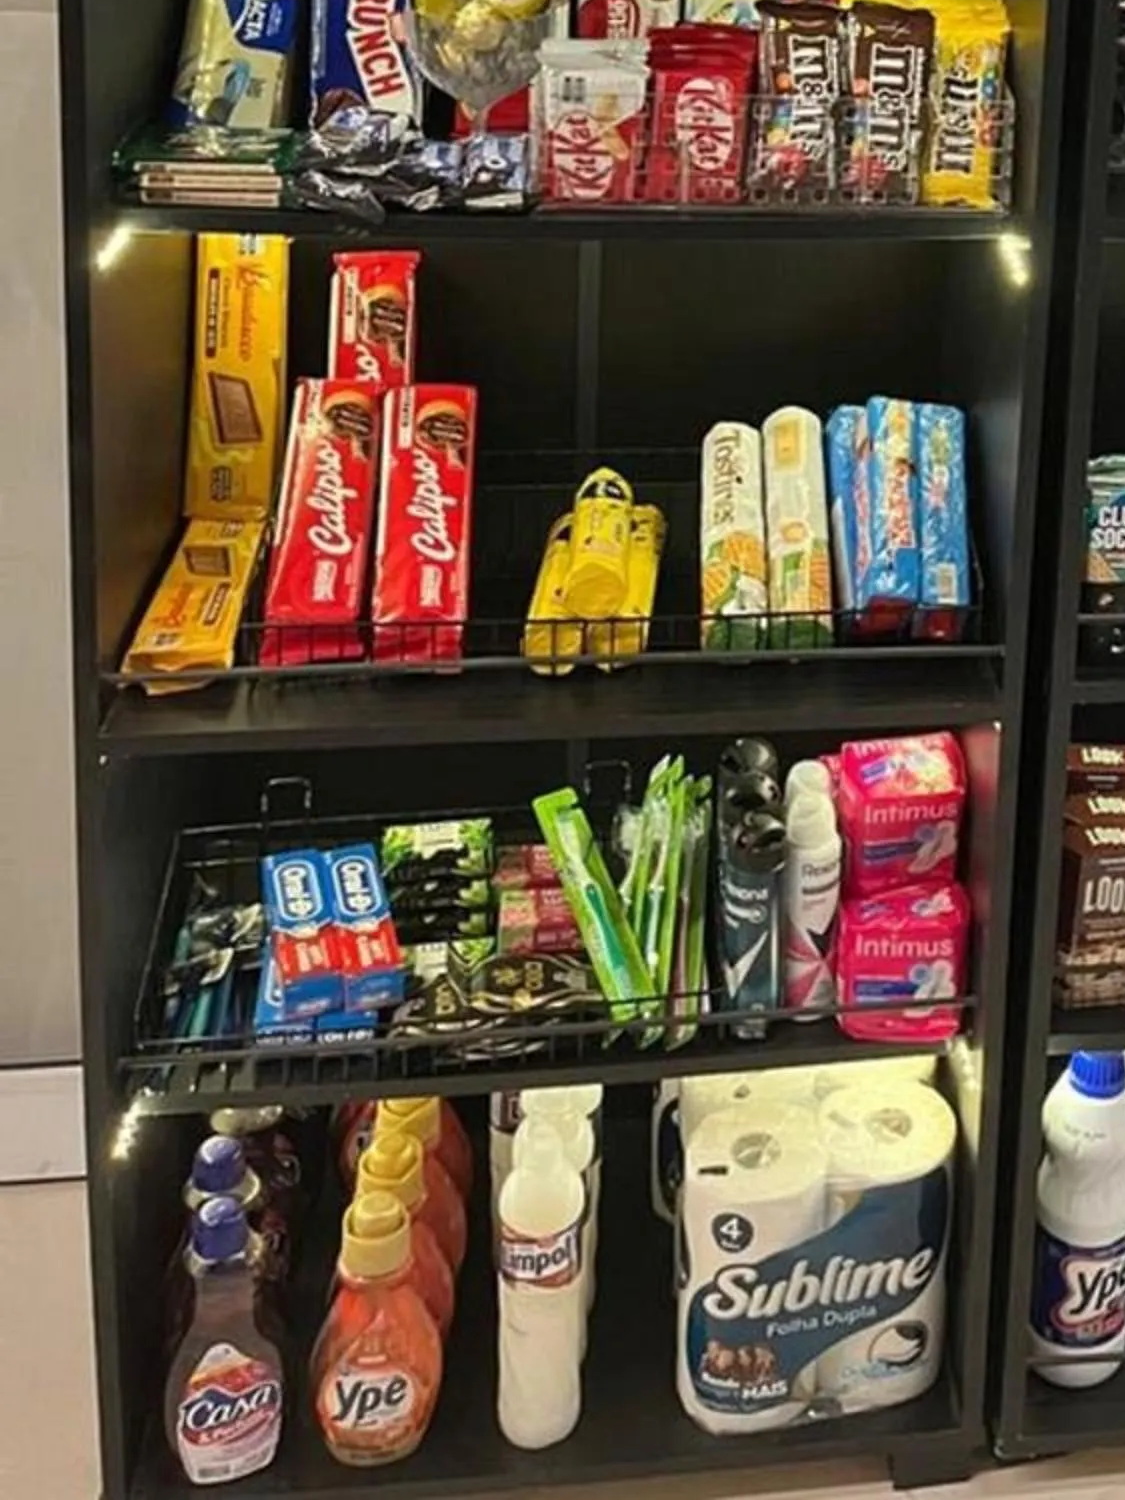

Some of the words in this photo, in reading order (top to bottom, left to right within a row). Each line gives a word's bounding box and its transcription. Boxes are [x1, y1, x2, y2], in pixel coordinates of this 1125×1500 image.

[305, 442, 359, 556] Calipso
[406, 450, 458, 562] Calipso
[1080, 746, 1125, 765] LOOK
[864, 802, 958, 825] Intimus
[854, 935, 955, 958] Intimus
[719, 1217, 743, 1241] 4
[502, 1236, 574, 1277] impol
[703, 1247, 934, 1321] Sublime
[766, 1317, 819, 1339] Folha
[822, 1303, 878, 1328] Dupla
[184, 1385, 273, 1430] Casa
